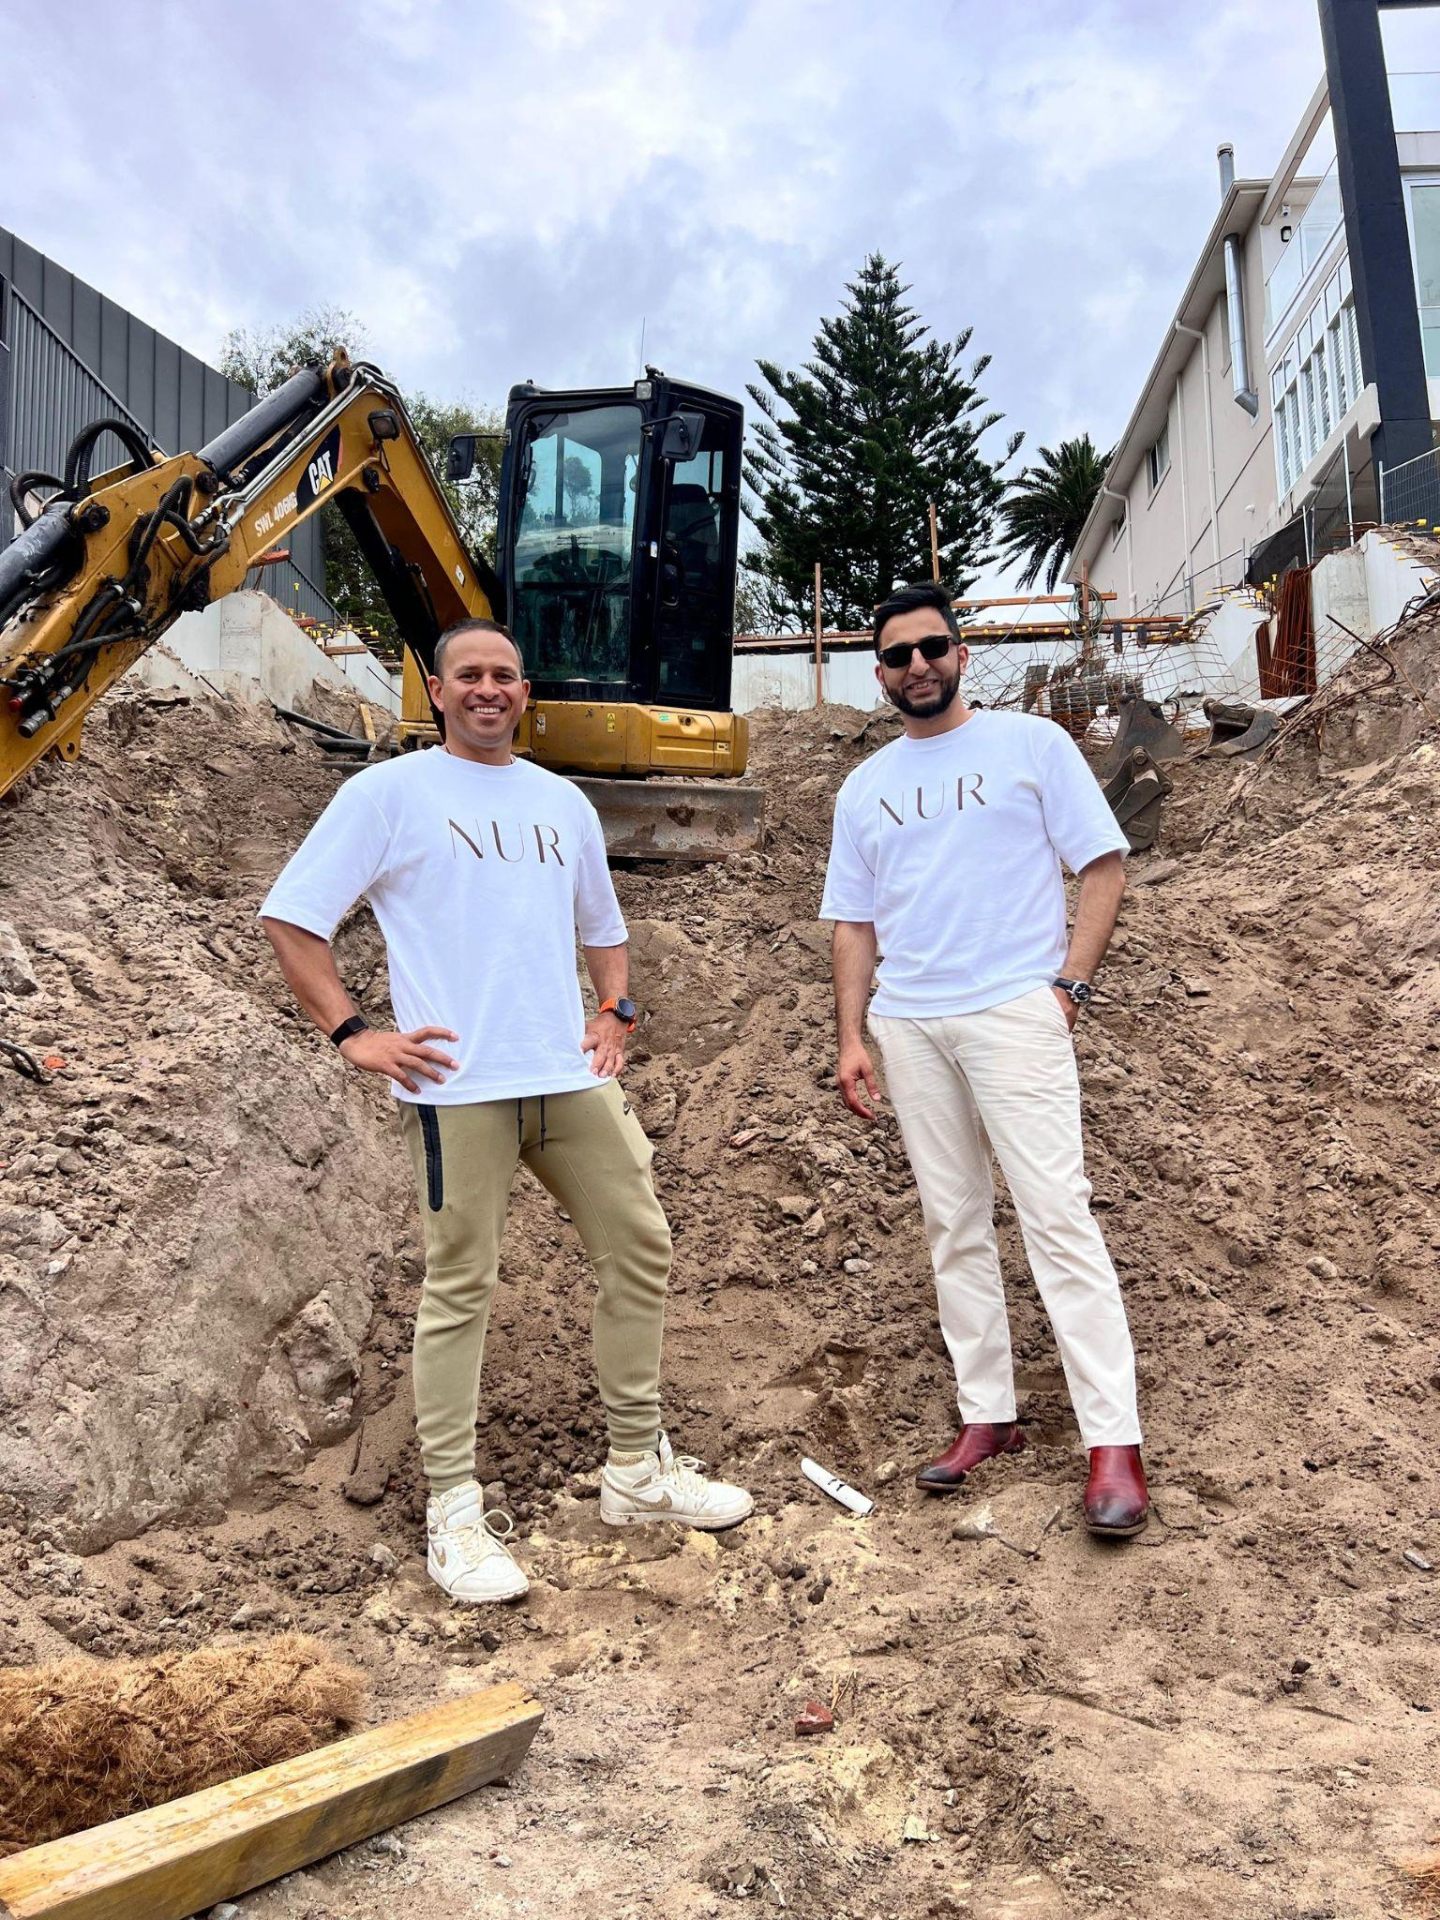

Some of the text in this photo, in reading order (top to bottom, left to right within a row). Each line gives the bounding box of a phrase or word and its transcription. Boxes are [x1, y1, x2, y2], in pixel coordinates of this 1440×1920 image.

[308, 450, 333, 495] CAT
[254, 512, 274, 537] SWL
[879, 773, 986, 832] NUR
[448, 818, 565, 866] NUR
